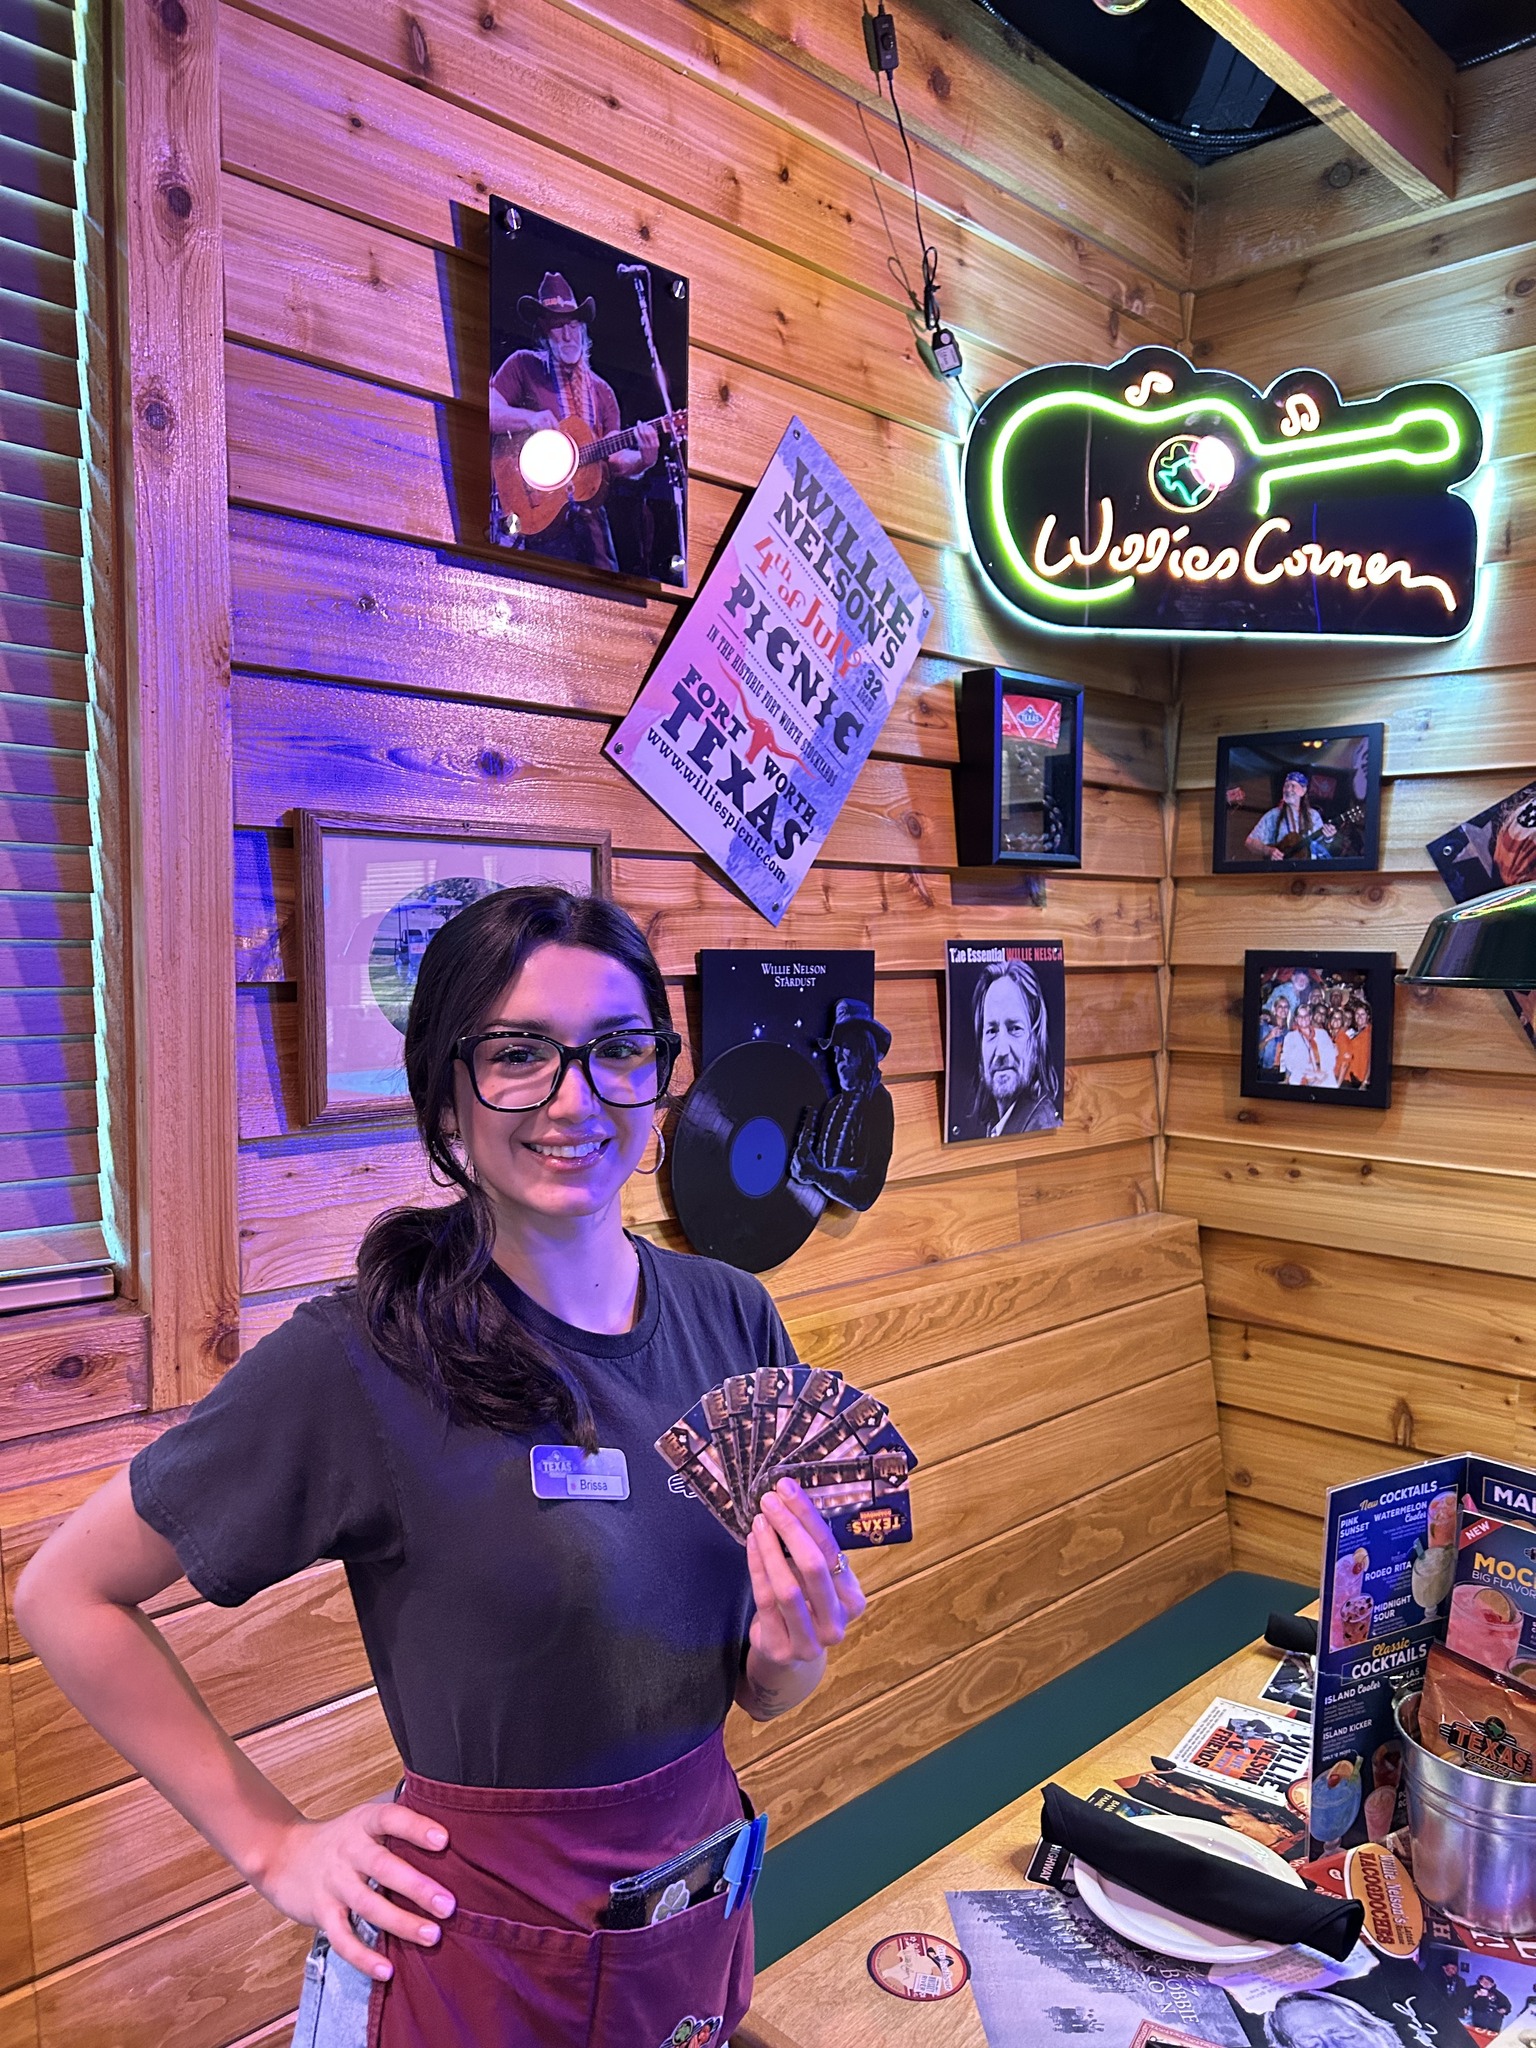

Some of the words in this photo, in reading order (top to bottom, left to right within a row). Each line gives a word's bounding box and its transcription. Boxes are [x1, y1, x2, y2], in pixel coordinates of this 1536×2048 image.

[793, 456, 913, 645] WILLIE
[1246, 517, 1458, 613] Corner
[752, 534, 794, 587] 4th
[778, 582, 807, 621] of
[773, 492, 900, 670] NELSON'S
[724, 574, 864, 756] PICNIC
[861, 667, 885, 701] 32
[706, 624, 719, 641] IN
[716, 636, 733, 660] THE
[731, 652, 767, 700] HISTORIC
[762, 690, 783, 718] FORT
[779, 709, 803, 744] WORTH
[799, 734, 839, 788] STOCKYARDS
[683, 664, 747, 741] FORT
[763, 755, 818, 834] WORTH,
[661, 683, 808, 862] TEXAS
[647, 728, 786, 884] www.williespicnic.com
[967, 947, 1005, 963] Essential
[1006, 947, 1033, 962] WILLIE
[542, 1461, 573, 1473] TEXAS
[580, 1479, 608, 1491] Brissa
[1360, 1499, 1379, 1511] New
[1380, 1480, 1438, 1506] COCKTAILS
[852, 1515, 901, 1535] TEXAS
[1340, 1516, 1359, 1529] PINK
[1374, 1501, 1428, 1522] WATERMELON
[1405, 1510, 1427, 1523] Cooler
[1340, 1522, 1370, 1539] SUNSET
[1465, 1521, 1490, 1541] NEW
[1365, 1567, 1392, 1582] RODEO
[1395, 1561, 1412, 1573] RITA
[1471, 1570, 1492, 1585] BIG
[1373, 1595, 1412, 1614] MIDNIGHT
[1373, 1609, 1396, 1623] SOUR
[1352, 1643, 1427, 1680] COCKTAILS
[1372, 1637, 1410, 1658] Classic
[1324, 1688, 1356, 1705] ISLAND
[1357, 1680, 1381, 1694] Cooler
[1322, 1727, 1348, 1740] ISLAND
[1349, 1719, 1373, 1732] KICKER
[1193, 1728, 1234, 1770] FRIENDS
[1239, 1740, 1282, 1785] NELSON
[1258, 1733, 1311, 1795] WILLIE
[1455, 1726, 1528, 1773] TEXAS
[1465, 1752, 1510, 1776] ROADHOUSE
[1039, 1844, 1063, 1882] HIGHWAY
[1378, 1853, 1396, 1881] Willie
[1358, 1851, 1395, 1945] NACOGDOCHES
[1386, 1881, 1407, 1926] Nelson's
[1404, 1925, 1416, 1946] Latest
[1160, 1968, 1200, 2025] BOBBIE
